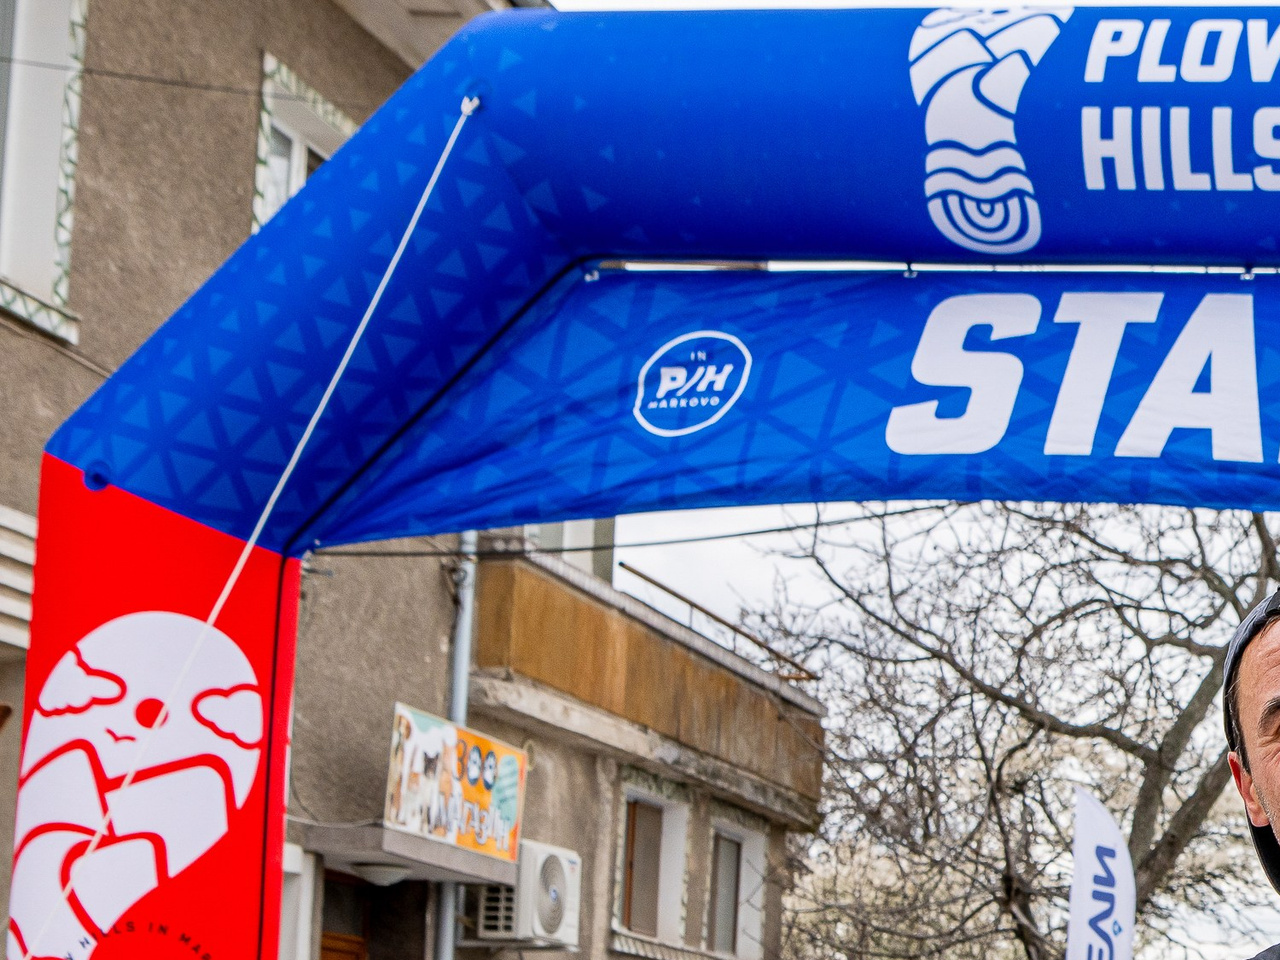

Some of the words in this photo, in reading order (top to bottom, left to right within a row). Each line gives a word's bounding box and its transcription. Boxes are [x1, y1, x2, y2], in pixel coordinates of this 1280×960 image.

[689, 350, 707, 362] IN
[655, 363, 734, 399] P/H
[647, 396, 720, 410] MARKOVO
